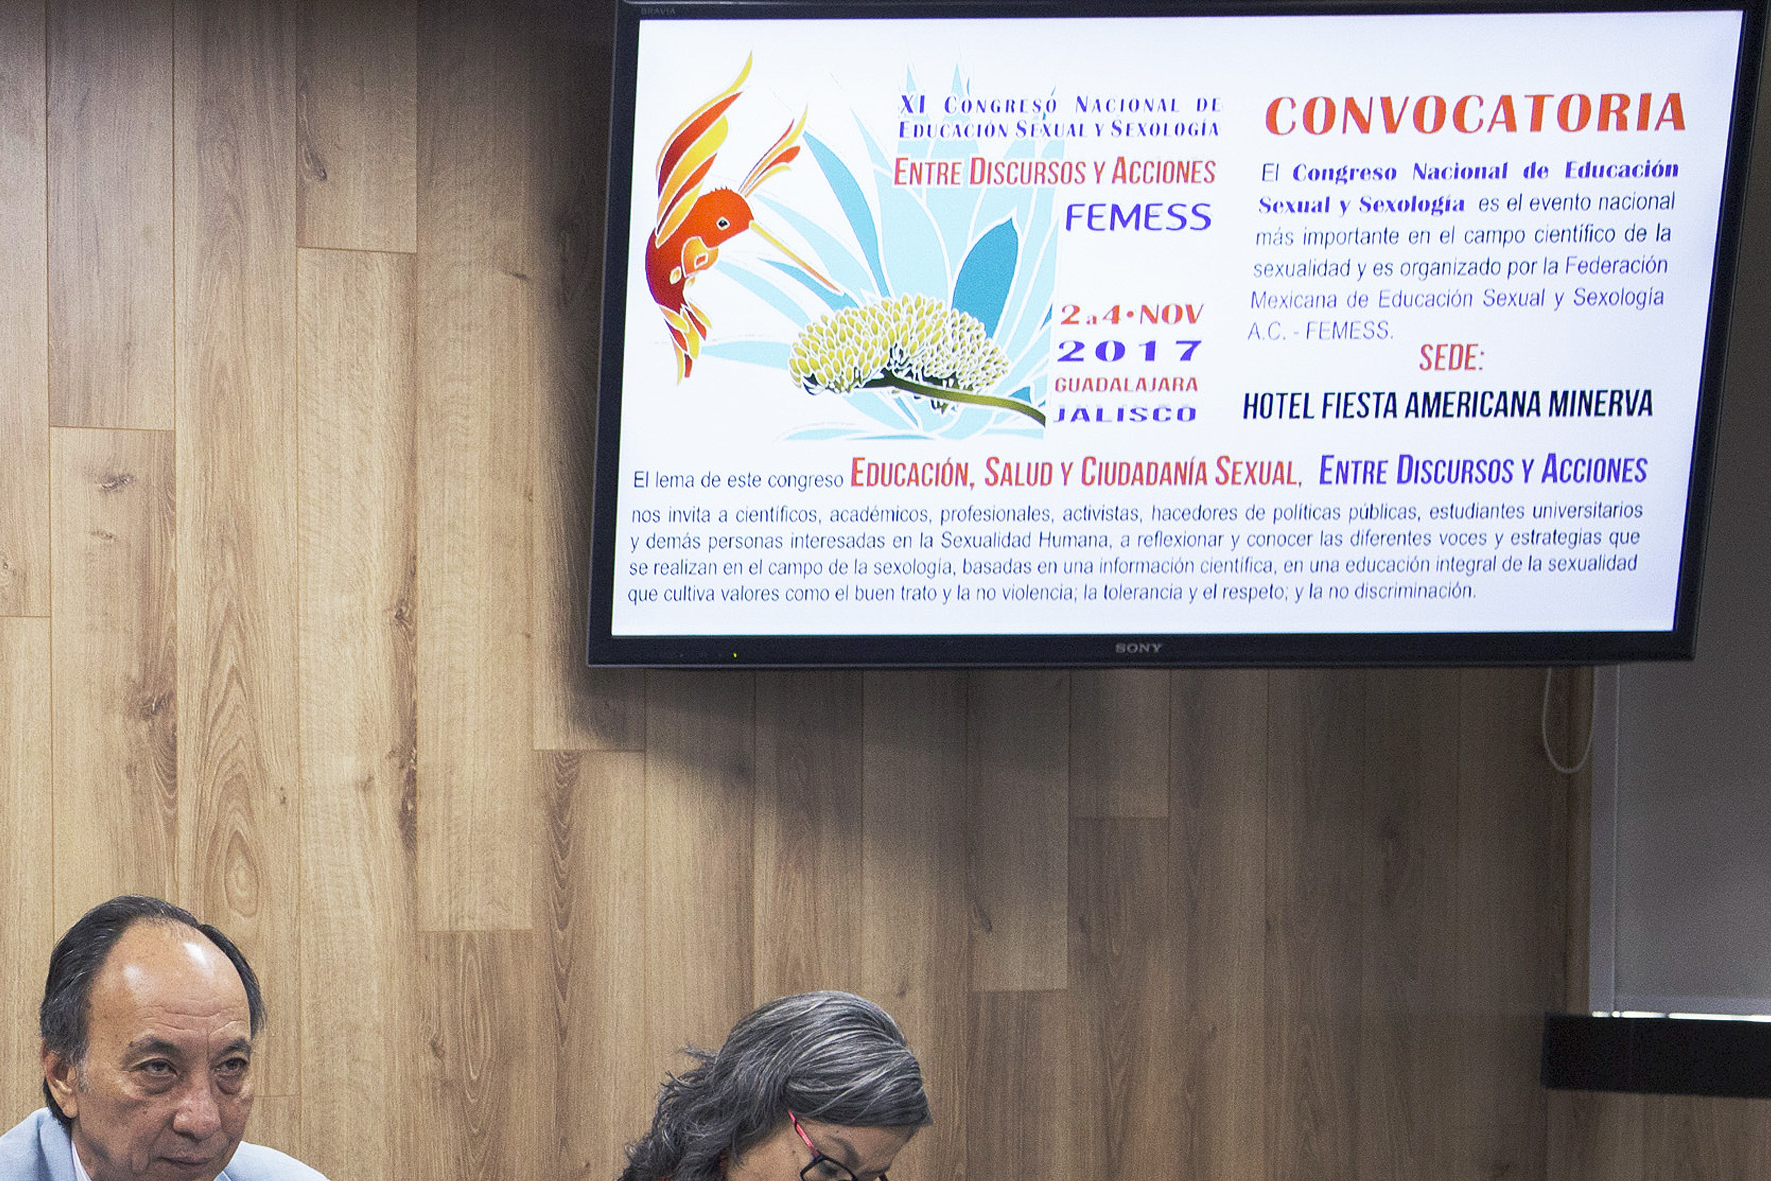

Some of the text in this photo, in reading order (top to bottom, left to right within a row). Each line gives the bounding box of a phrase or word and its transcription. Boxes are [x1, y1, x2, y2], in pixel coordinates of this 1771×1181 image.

[901, 95, 925, 113] XI
[1076, 96, 1179, 112] NACIONAL
[1197, 98, 1221, 112] DE
[1266, 93, 1685, 135] CONVOCATORIA
[900, 120, 1218, 138] EDUCACIÓN SEXUAL Y SEXOLOGÍA
[894, 156, 1216, 185] ENTRE DISCURSOS Y ACCIONES
[1262, 159, 1678, 184] El Congreso Nacional de Educación
[1259, 191, 1675, 216] Sexual y Sexología es el evento nacional
[1066, 203, 1211, 231] FEMESS
[1256, 222, 1671, 250] más importante en el campo científico de la
[1254, 255, 1668, 281] sexualidad y es organizado por la Federación
[1251, 286, 1664, 311] Mexicana de Educación Sexual y Sexología
[1248, 320, 1393, 340] A.C. FEMESS.
[1057, 340, 1202, 362] 2017
[1419, 344, 1484, 371] SEDE:
[1055, 377, 1197, 392] GUADALAJARA
[1054, 407, 1196, 422] JALISCO
[1243, 388, 1653, 419] HOTEL FIESTA AMERICANA MINERVA
[634, 452, 1648, 492] El lema de este congreso EDUCACIÓN, SALUD Y CIUDADANÍA SEXUAL, ENTRE DISCURSOS Y ACCIONES
[632, 501, 1643, 526] nos invita a científicos, académicos, profesionales, activistas, hacedores de políticas públicas, estudiantes universitarios
[631, 528, 1640, 553] y demás personas interesadas en la Sexualidad Humana, a reflexionar y conocer las diferentes voces y estrategias que
[874, 557, 1194, 579] sexología, basadas en una información
[1115, 642, 1164, 654] SONY
